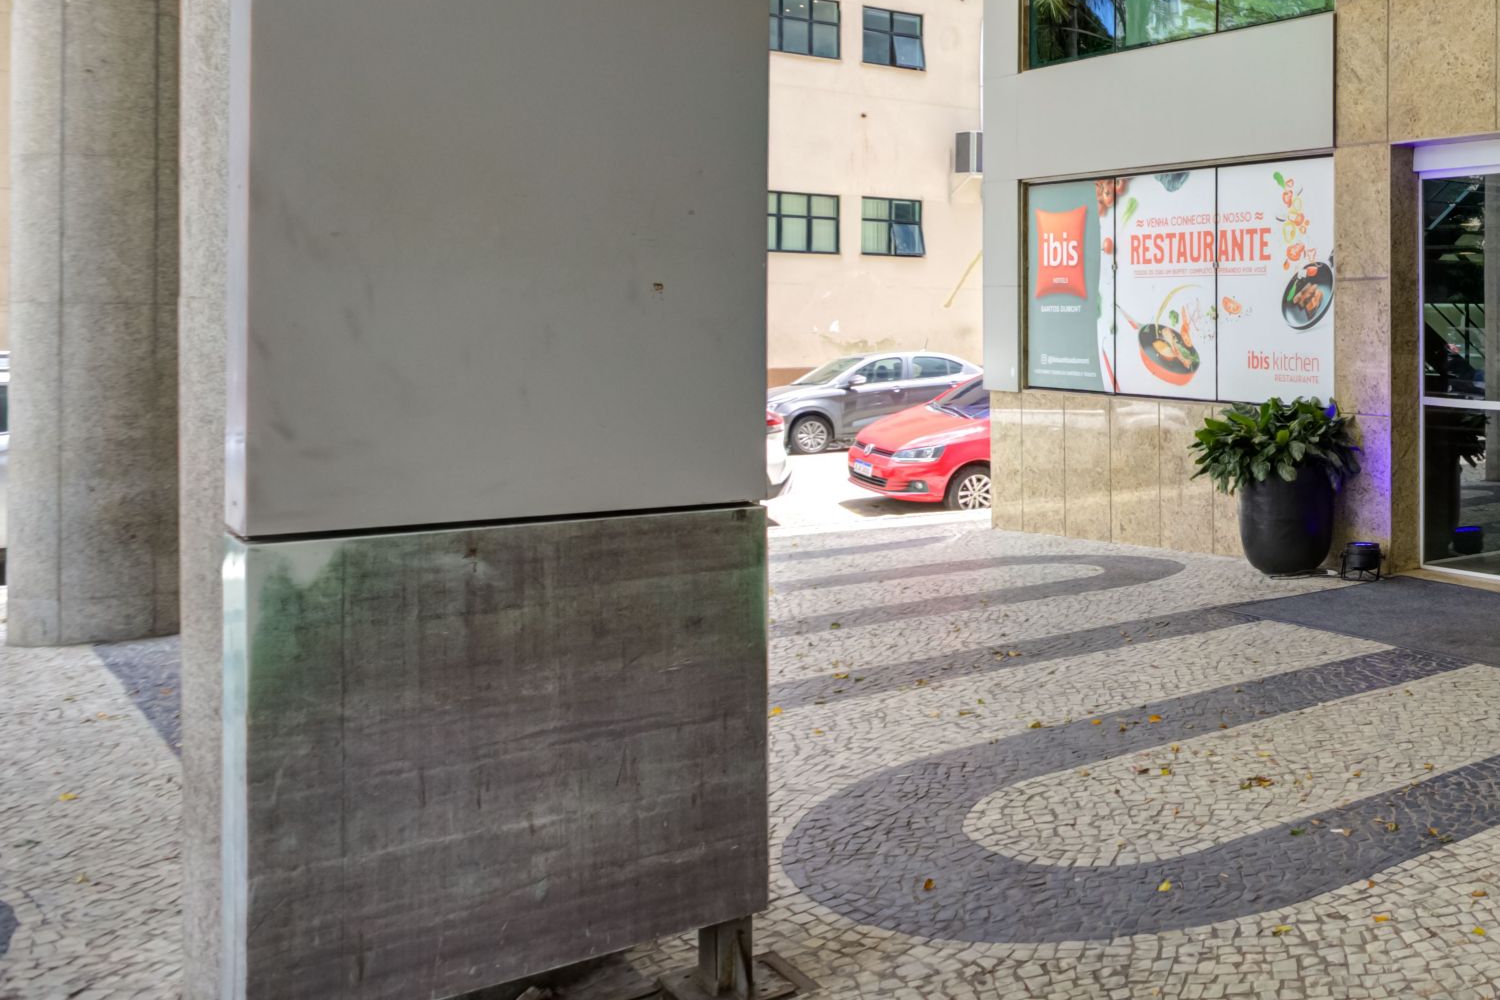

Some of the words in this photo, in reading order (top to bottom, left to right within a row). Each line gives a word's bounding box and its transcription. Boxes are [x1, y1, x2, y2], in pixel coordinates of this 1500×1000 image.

[1147, 218, 1168, 228] VENHA
[1171, 214, 1211, 227] CONHECER
[1223, 211, 1252, 223] NOSSO
[1043, 231, 1079, 267] ibis
[1130, 227, 1272, 265] RESTAURANTE
[1247, 350, 1270, 370] ibis
[1273, 351, 1320, 372] kitchen
[1274, 374, 1319, 384] RESTAURANTE
